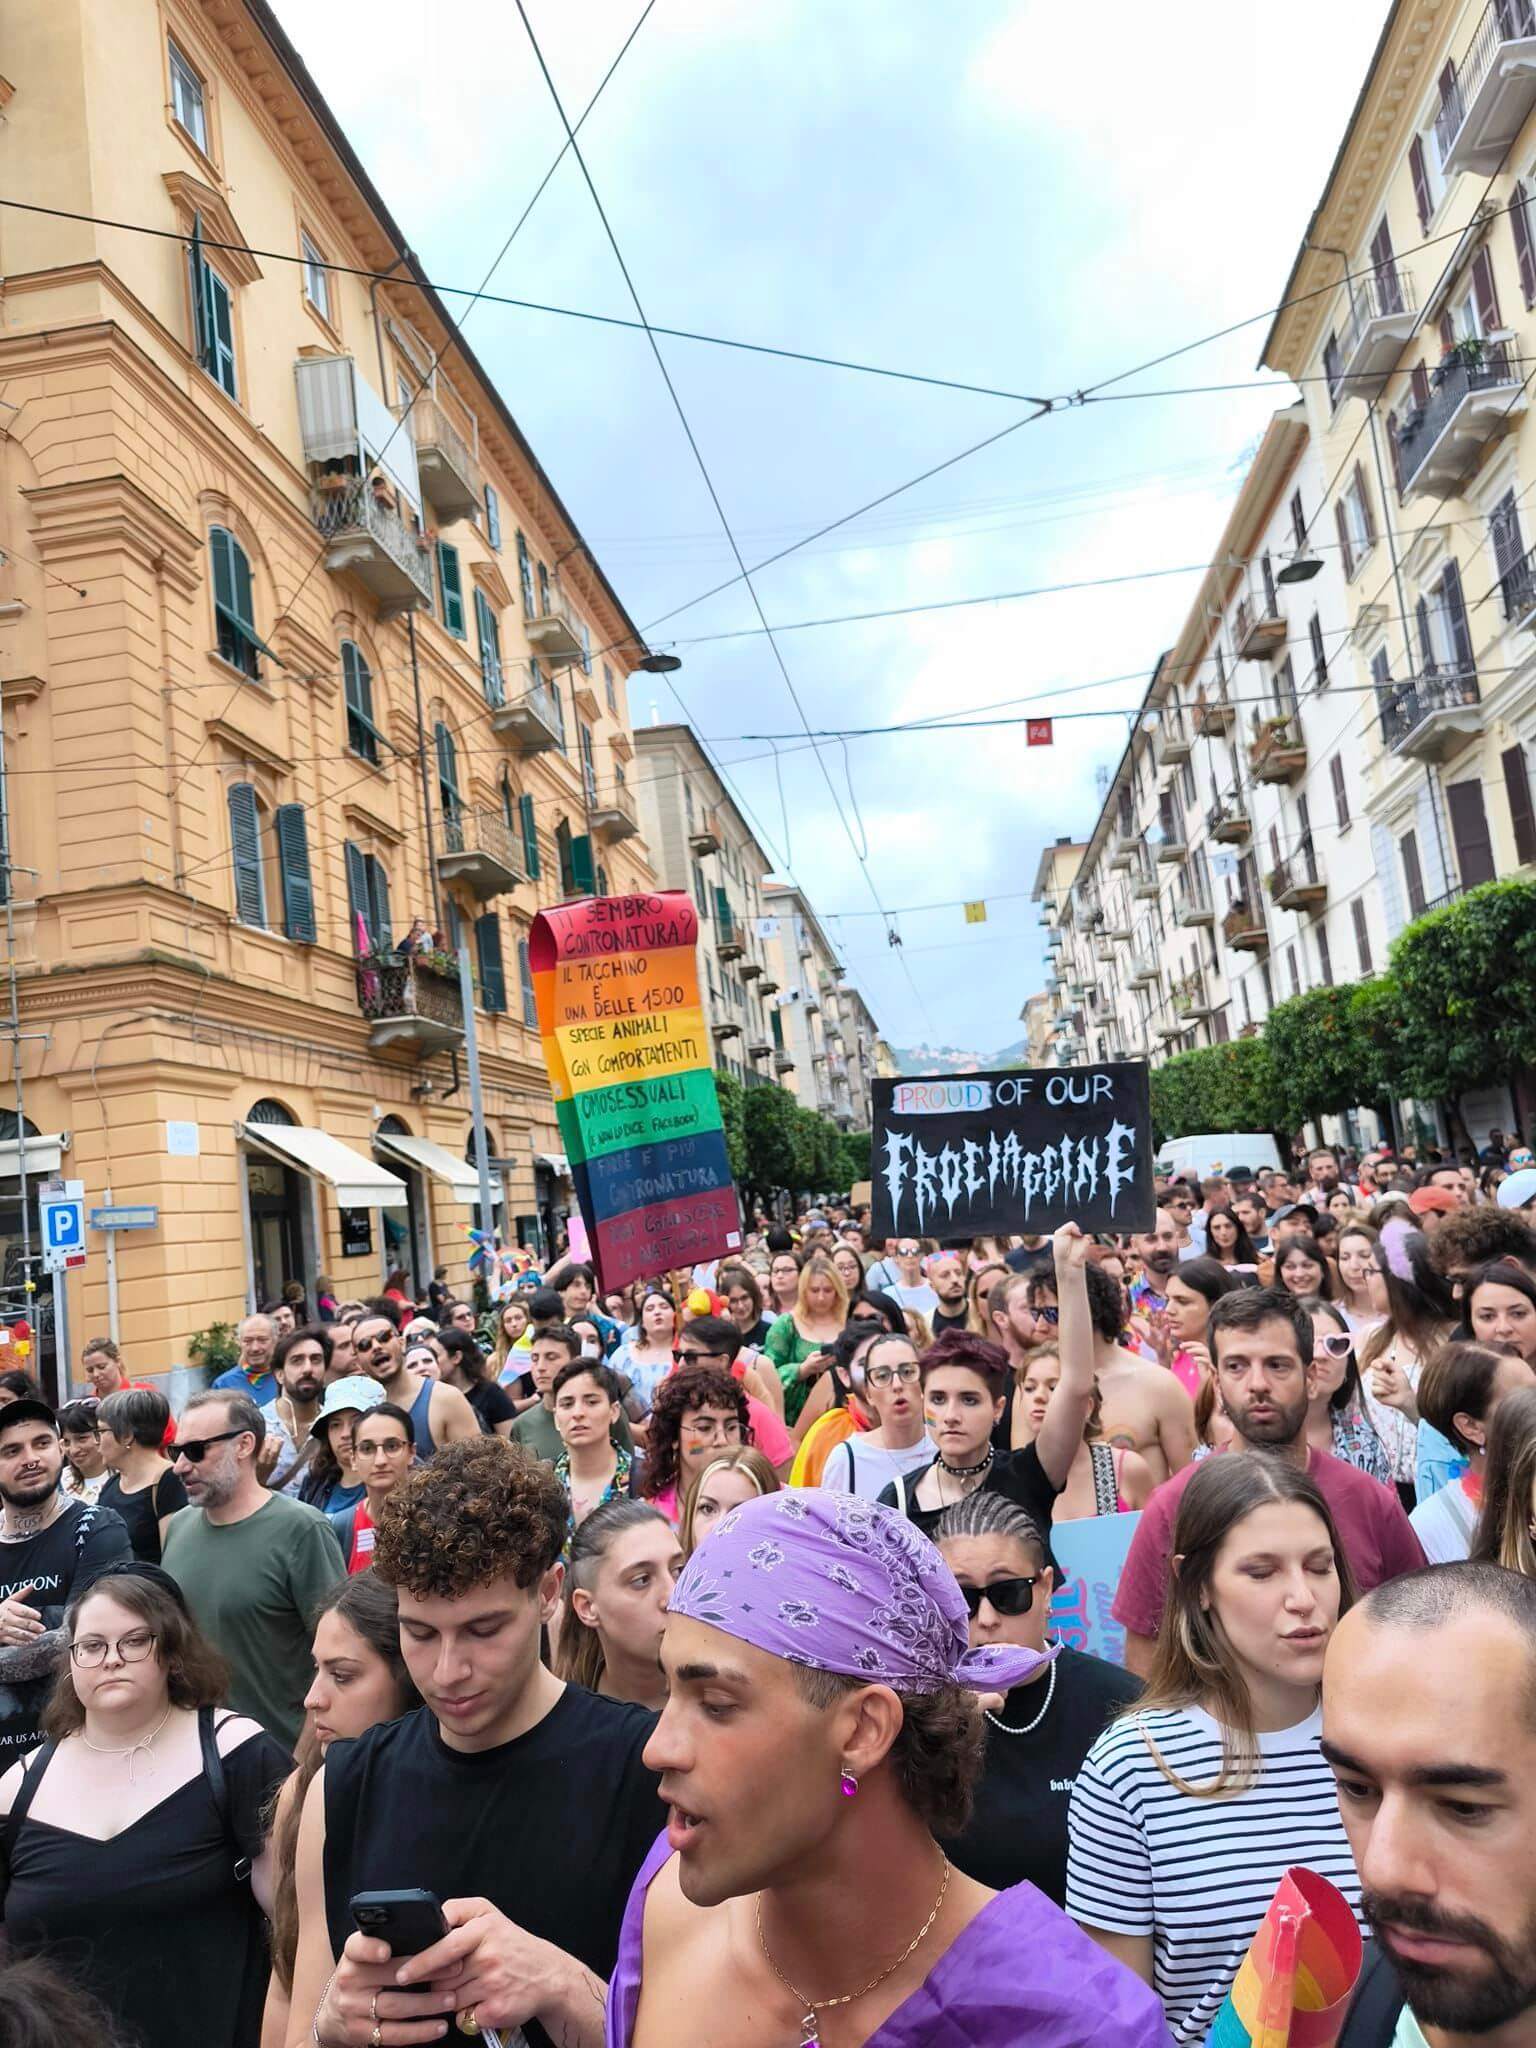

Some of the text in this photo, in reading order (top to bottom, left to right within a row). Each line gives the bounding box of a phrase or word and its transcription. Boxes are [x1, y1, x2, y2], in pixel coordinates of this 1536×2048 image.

[586, 896, 663, 924] SEMBRO
[565, 909, 693, 954] CONTRONATURA?
[563, 958, 648, 984] IL TACCHINO
[565, 986, 684, 1020] UNA DELLE 1500
[569, 1015, 667, 1043] SPECIE ANIMALI
[571, 1039, 698, 1077] CON COMPORTAMENTI
[581, 1077, 686, 1120] OMOSESSUALI
[900, 1074, 1114, 1111] PROUD OF OUR
[881, 1117, 1136, 1235] FROCIAGGINE
[54, 1210, 73, 1242] P
[16, 1733, 28, 1744] US
